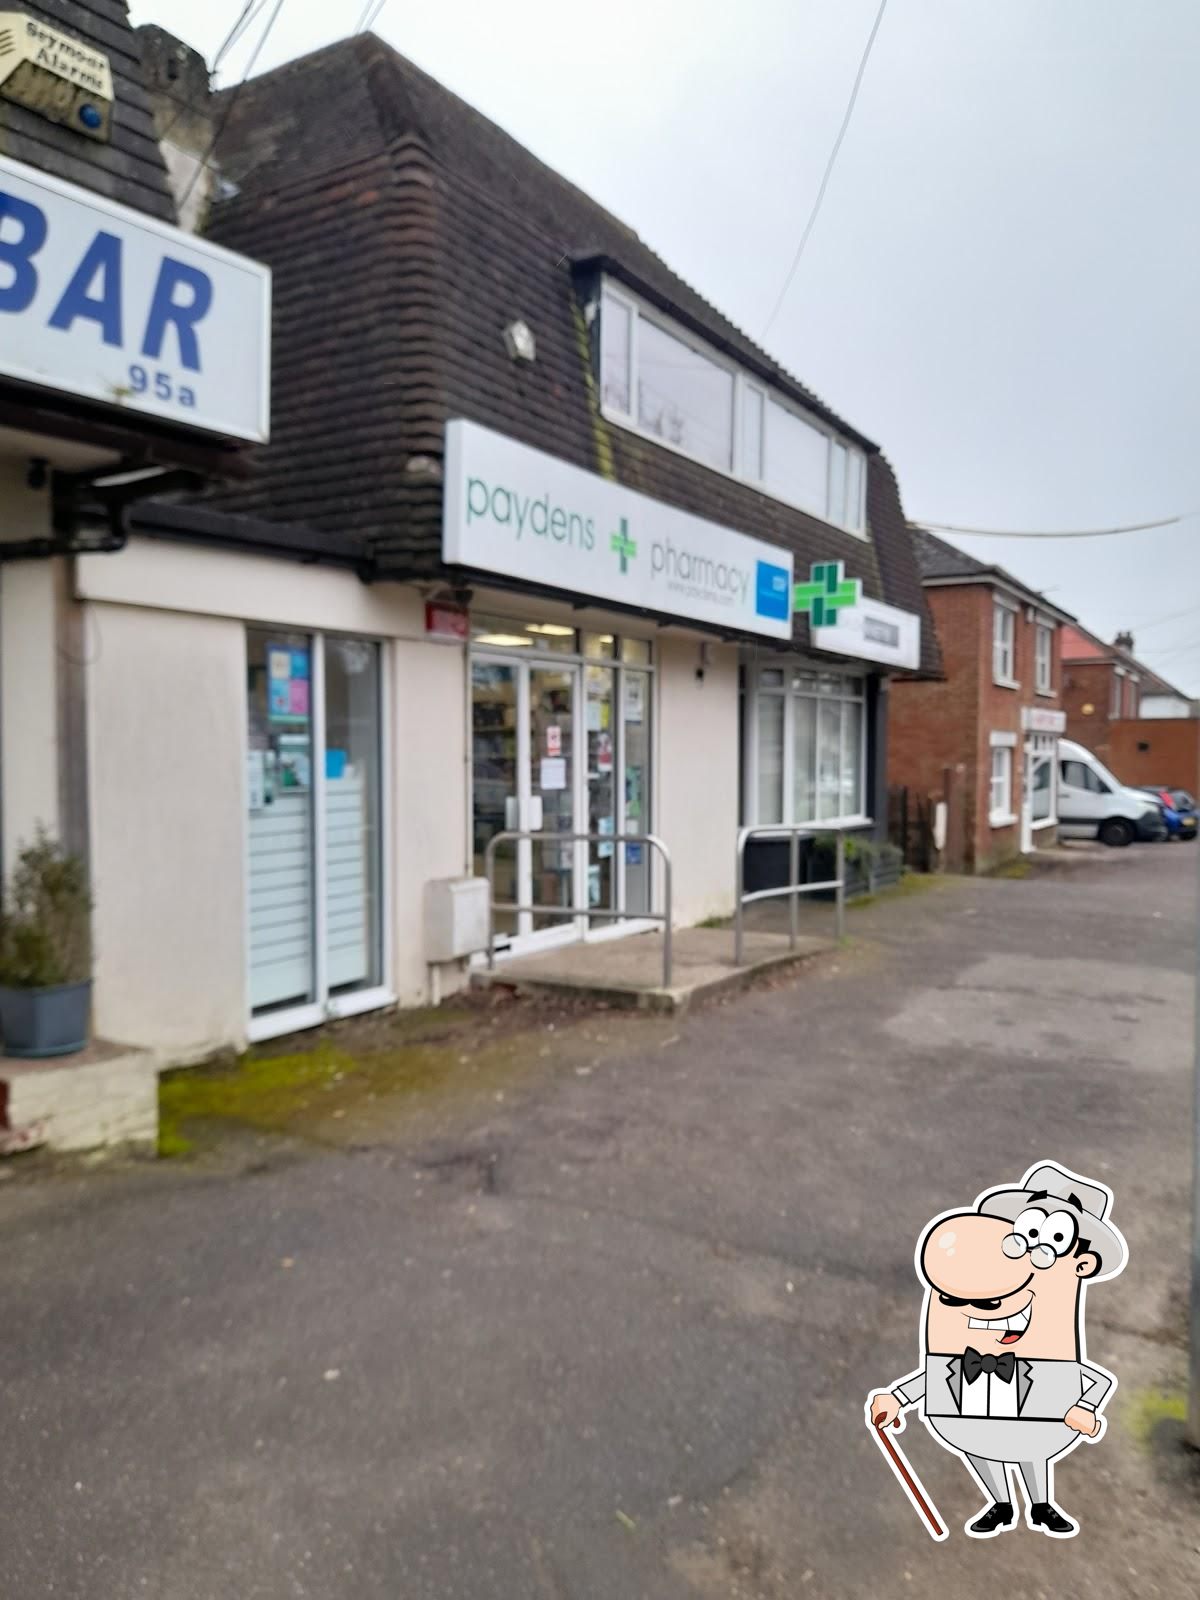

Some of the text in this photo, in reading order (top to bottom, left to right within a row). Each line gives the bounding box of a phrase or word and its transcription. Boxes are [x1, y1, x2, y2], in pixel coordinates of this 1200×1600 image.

[37, 47, 103, 89] Alarms
[0, 190, 214, 374] BAR
[128, 364, 196, 408] 95a
[466, 476, 750, 605] paydens pharmacy
